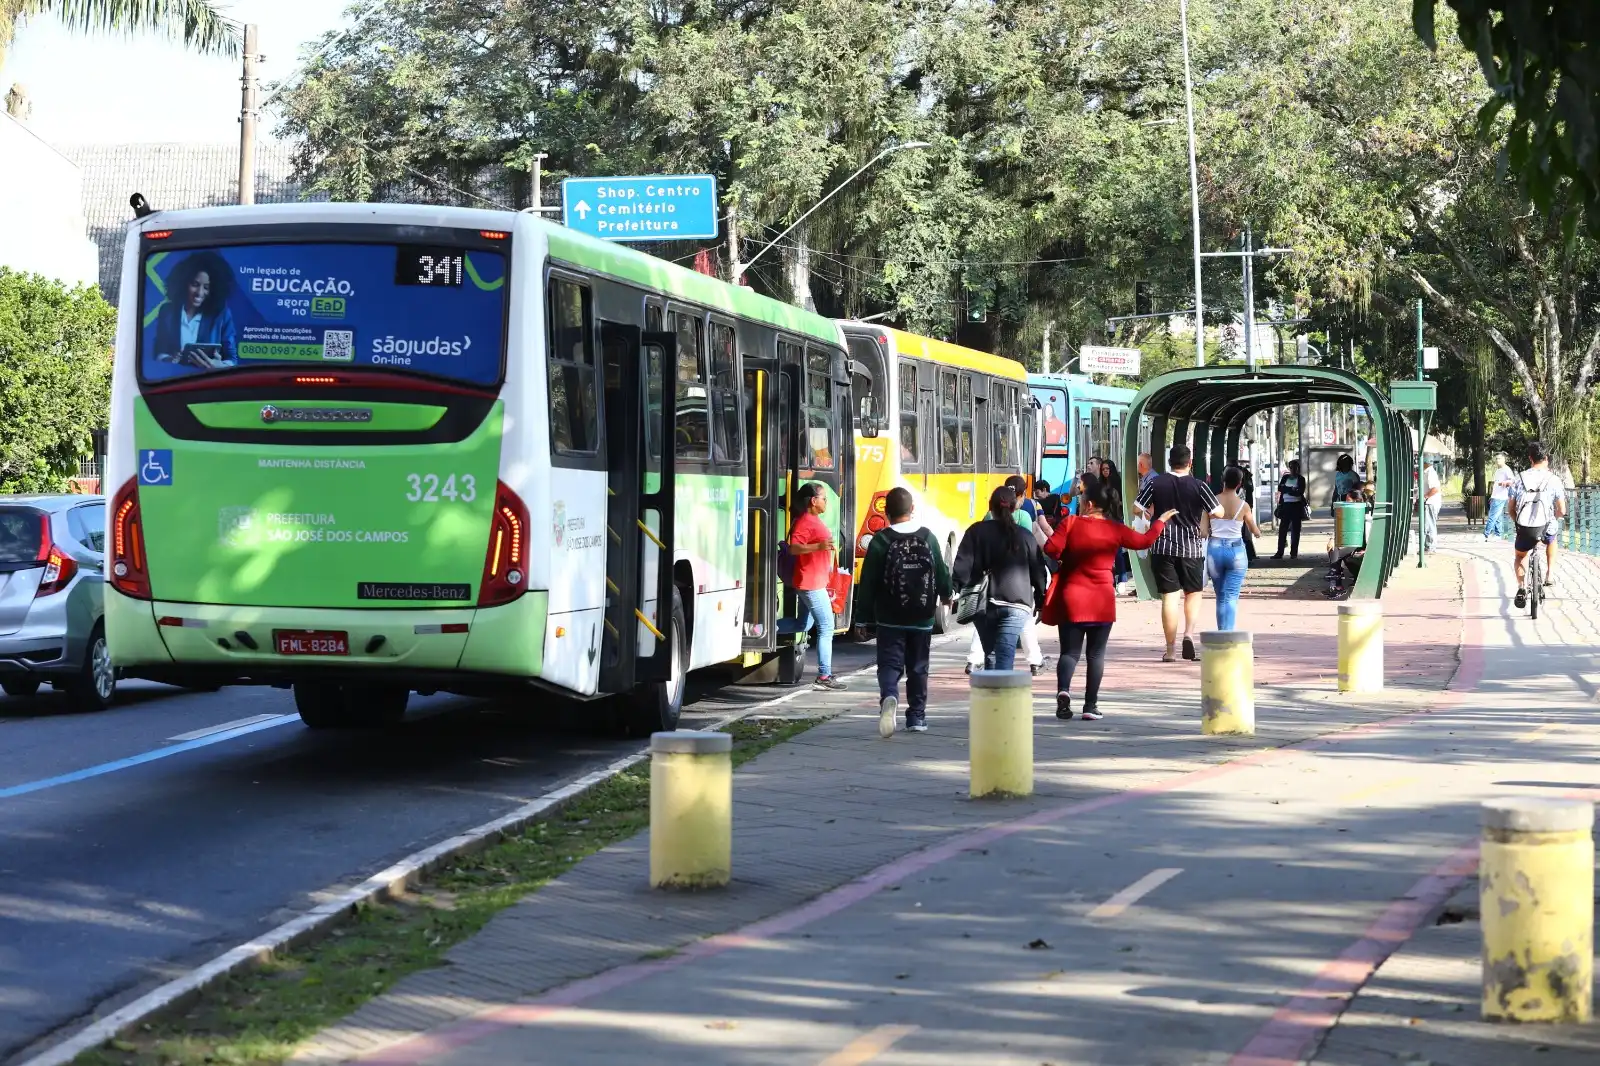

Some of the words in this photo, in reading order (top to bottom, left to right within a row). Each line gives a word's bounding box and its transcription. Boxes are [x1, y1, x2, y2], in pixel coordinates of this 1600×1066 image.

[597, 187, 640, 199] Shop.
[645, 185, 700, 197] Centro
[597, 202, 676, 215] Cemitério
[597, 219, 679, 231] Prefeitura
[239, 266, 255, 274] Um
[257, 266, 288, 276] legado
[418, 255, 462, 284] 341
[252, 276, 355, 297] EDUCAÇÃO,
[277, 299, 310, 308] agora
[315, 299, 343, 311] EaD
[243, 326, 273, 334] Aproveite
[281, 327, 313, 335] condições
[242, 333, 271, 341] especiais
[280, 334, 317, 342] lançamento
[242, 345, 269, 355] 0800
[270, 346, 297, 356] 0987
[372, 335, 462, 357] sãojudas
[371, 355, 412, 365] On-line
[258, 459, 312, 468] MANTENHA
[313, 459, 365, 469] DISTÂNCIA
[406, 473, 477, 502] 3243
[266, 513, 336, 525] PREFEITURA
[294, 528, 324, 542] JOSÉ
[326, 530, 352, 542] DOS
[355, 531, 409, 543] CAMPOS
[363, 584, 465, 599] Mercedes-Benz
